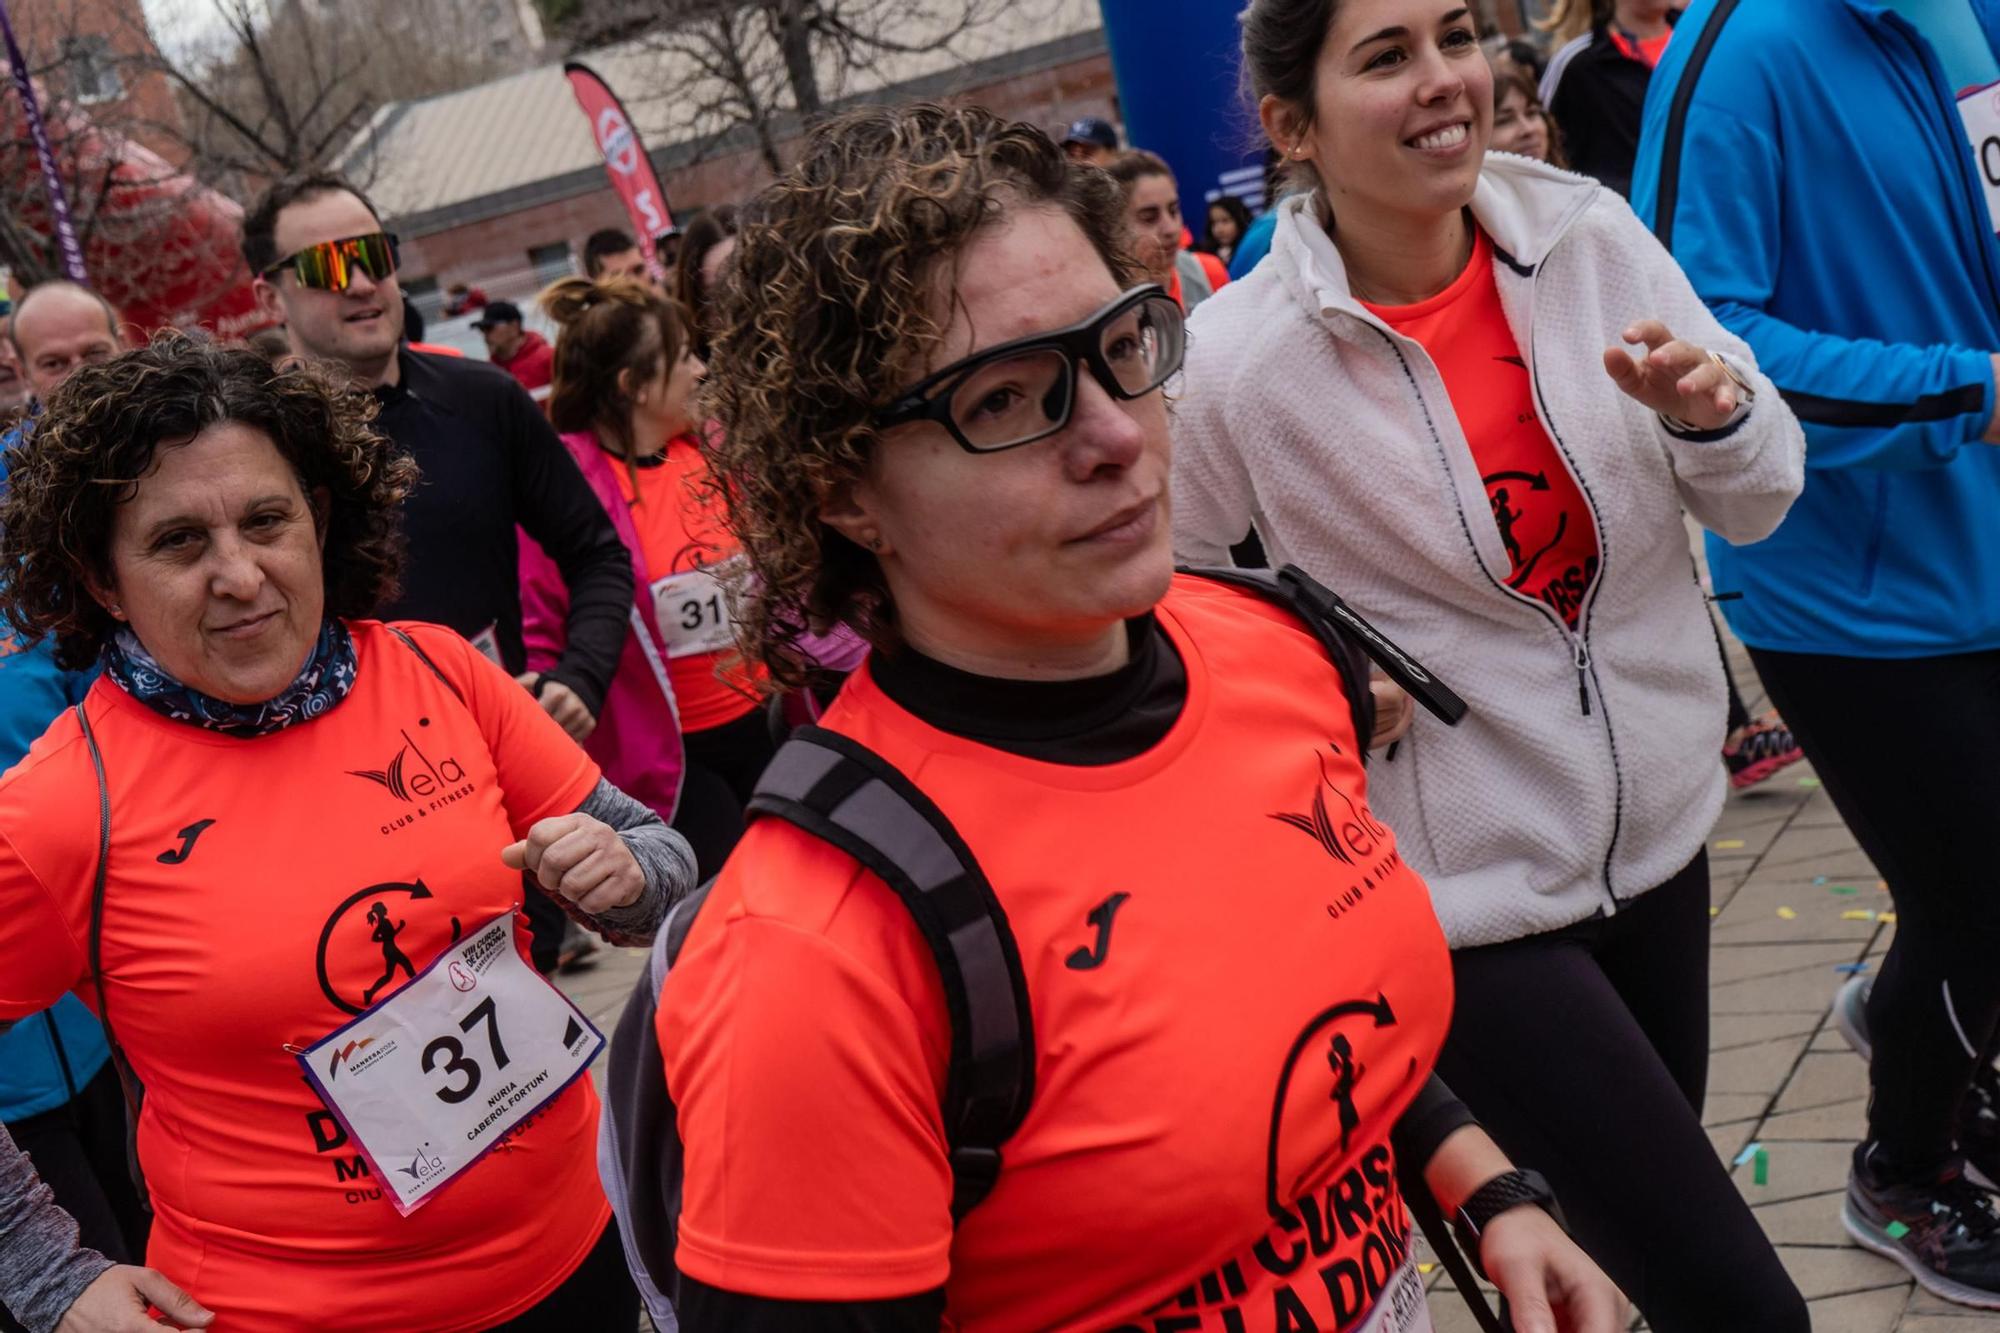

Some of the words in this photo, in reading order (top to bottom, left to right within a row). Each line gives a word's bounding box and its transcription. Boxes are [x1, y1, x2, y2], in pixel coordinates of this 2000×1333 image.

[682, 595, 721, 630] 31
[381, 814, 414, 835] CLUB
[418, 808, 426, 817] &
[430, 783, 475, 811] FITNESS
[462, 944, 476, 959] VIII
[476, 926, 502, 949] CURSA
[465, 954, 477, 968] DE
[485, 930, 507, 951] DONA
[421, 995, 510, 1104] 37
[467, 1105, 509, 1141] CABEROL
[507, 1069, 550, 1107] FORTUNY
[1252, 1144, 1392, 1277] CURS
